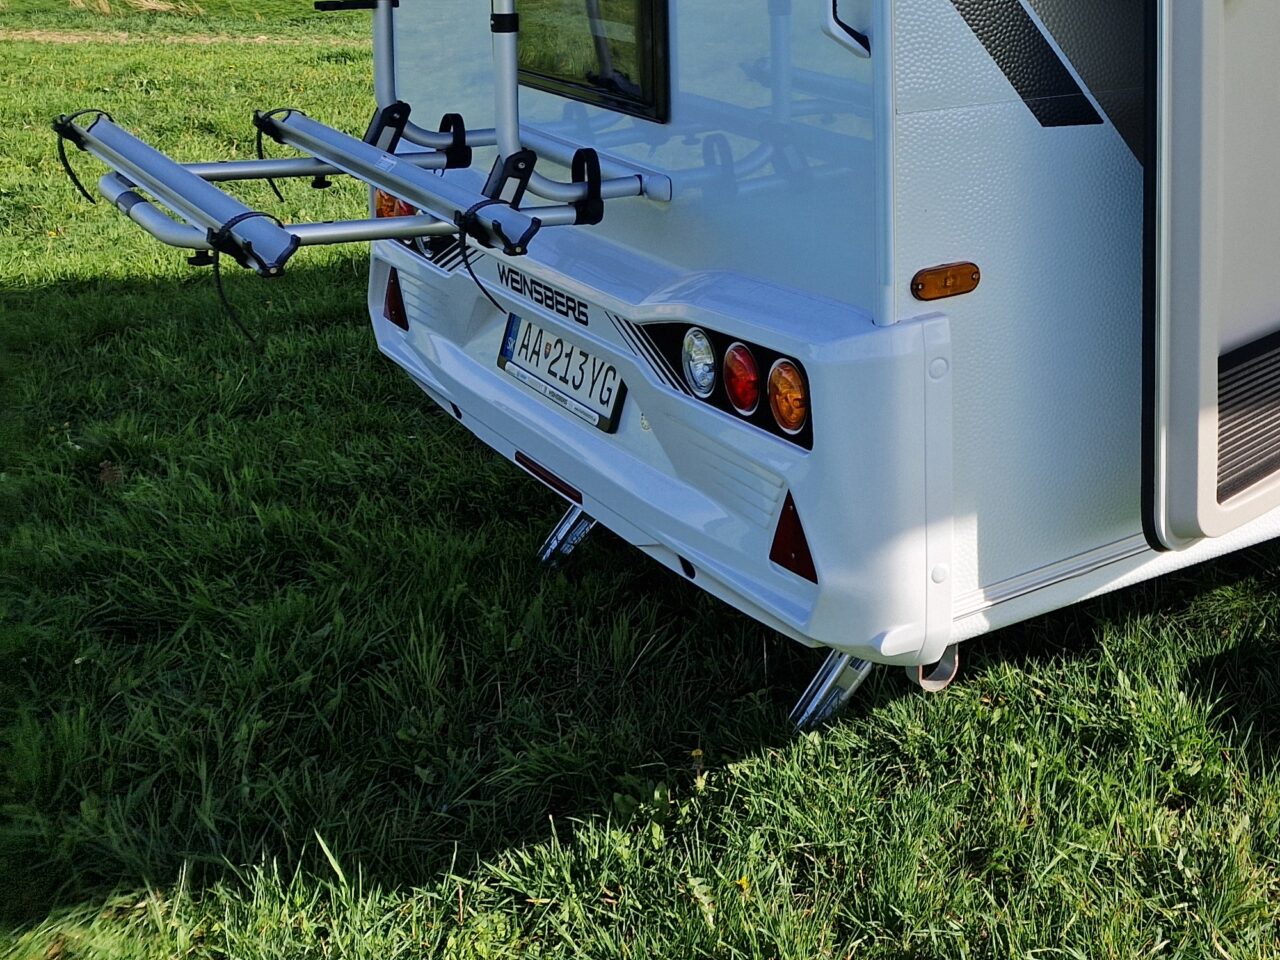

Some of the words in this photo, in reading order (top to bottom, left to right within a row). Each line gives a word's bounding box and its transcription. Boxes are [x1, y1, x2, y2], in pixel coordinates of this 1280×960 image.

[497, 262, 589, 327] WEINSBERG
[517, 322, 544, 368] AA
[547, 338, 617, 408] 213YG
